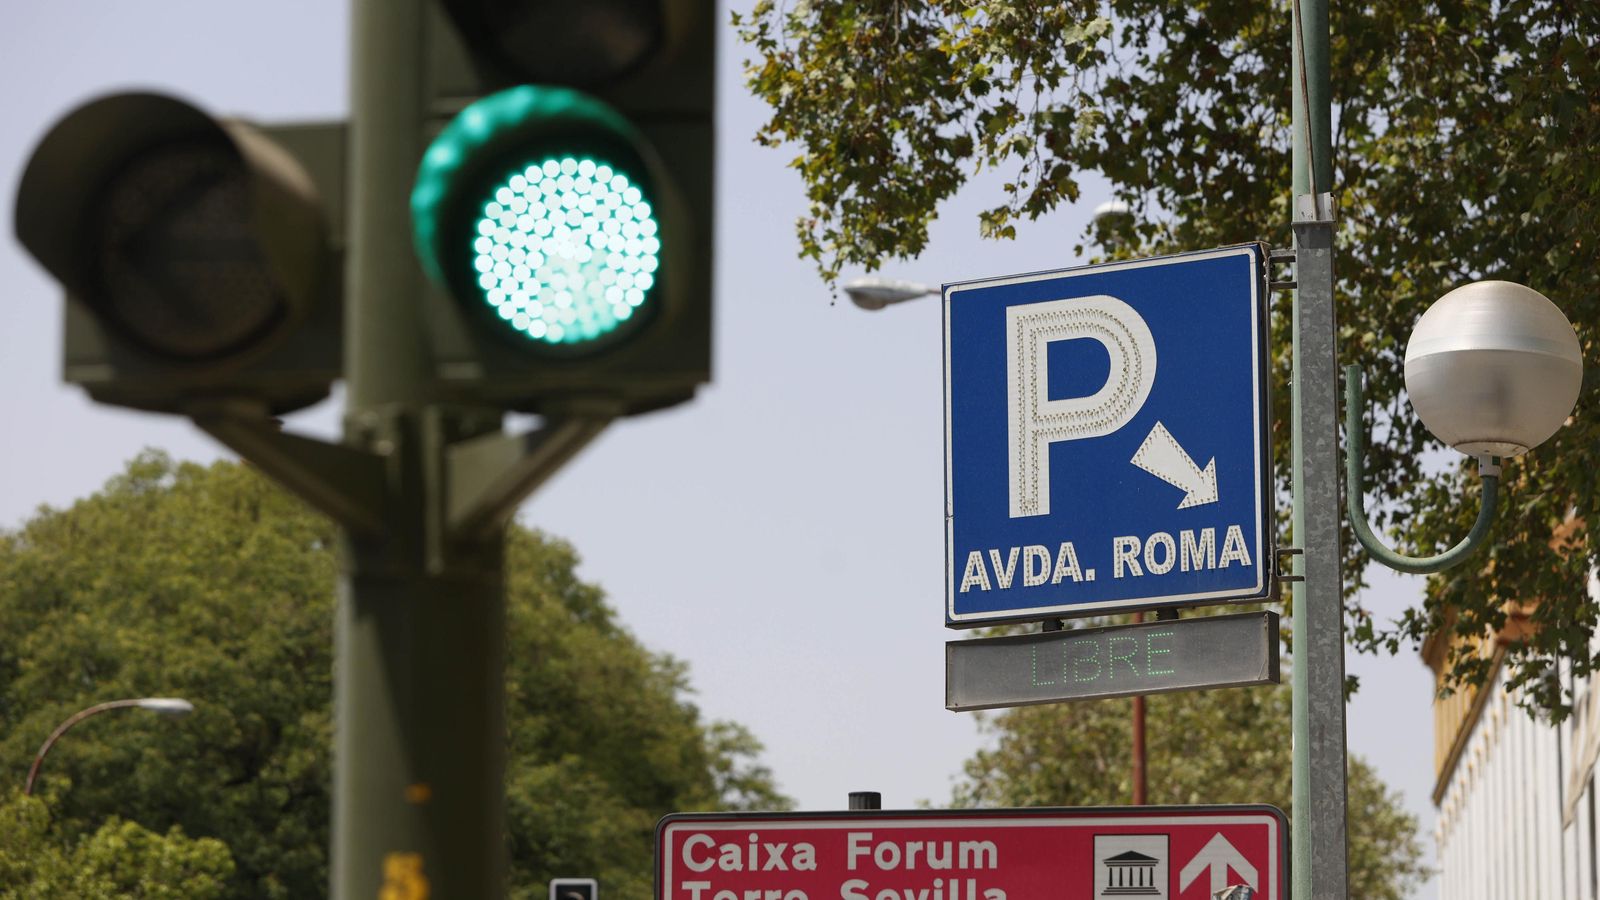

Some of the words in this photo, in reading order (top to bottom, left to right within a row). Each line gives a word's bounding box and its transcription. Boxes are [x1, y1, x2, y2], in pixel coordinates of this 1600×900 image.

[1005, 294, 1158, 519] P
[959, 541, 1096, 593] AVDA.
[1113, 524, 1252, 579] ROMA
[1032, 631, 1175, 687] LIBRE
[682, 832, 817, 872] Caixa
[847, 832, 998, 871] Forum
